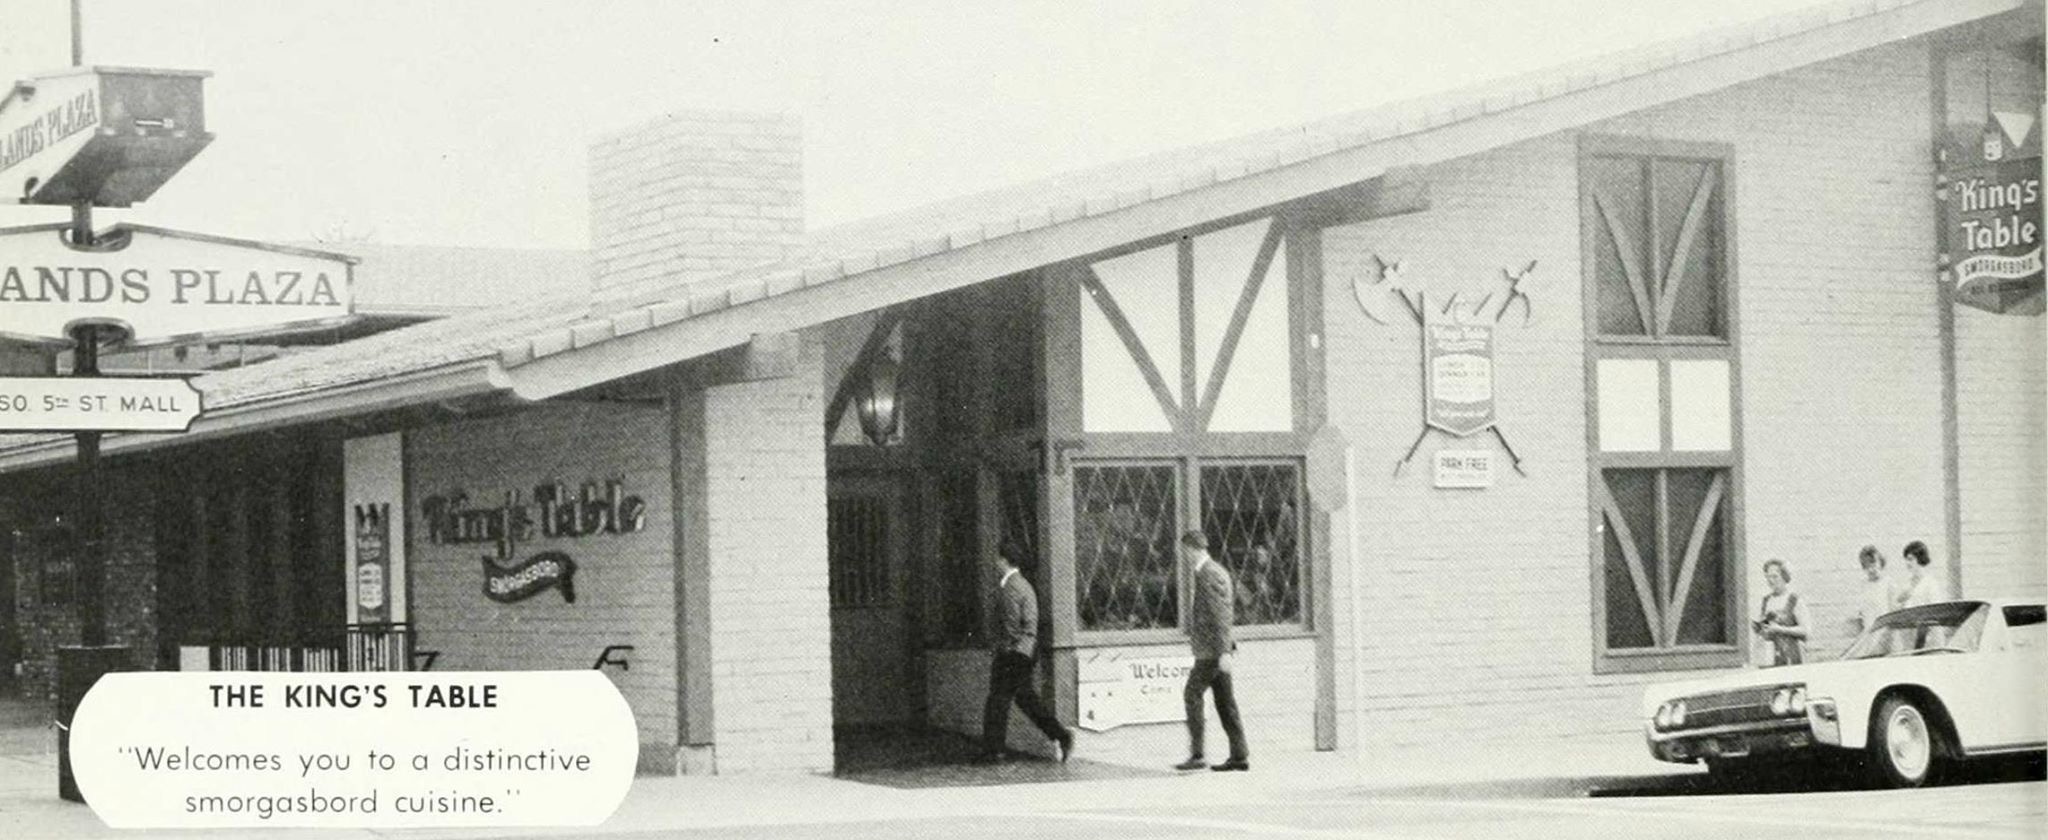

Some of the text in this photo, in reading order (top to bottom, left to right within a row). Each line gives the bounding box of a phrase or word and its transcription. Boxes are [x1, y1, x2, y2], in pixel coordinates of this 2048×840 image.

[47, 88, 98, 147] PLAZA
[1955, 179, 2039, 212] King's
[1961, 215, 2036, 250] Table
[170, 269, 341, 306] PLAZA
[120, 396, 181, 412] MALL
[534, 479, 647, 539] Table
